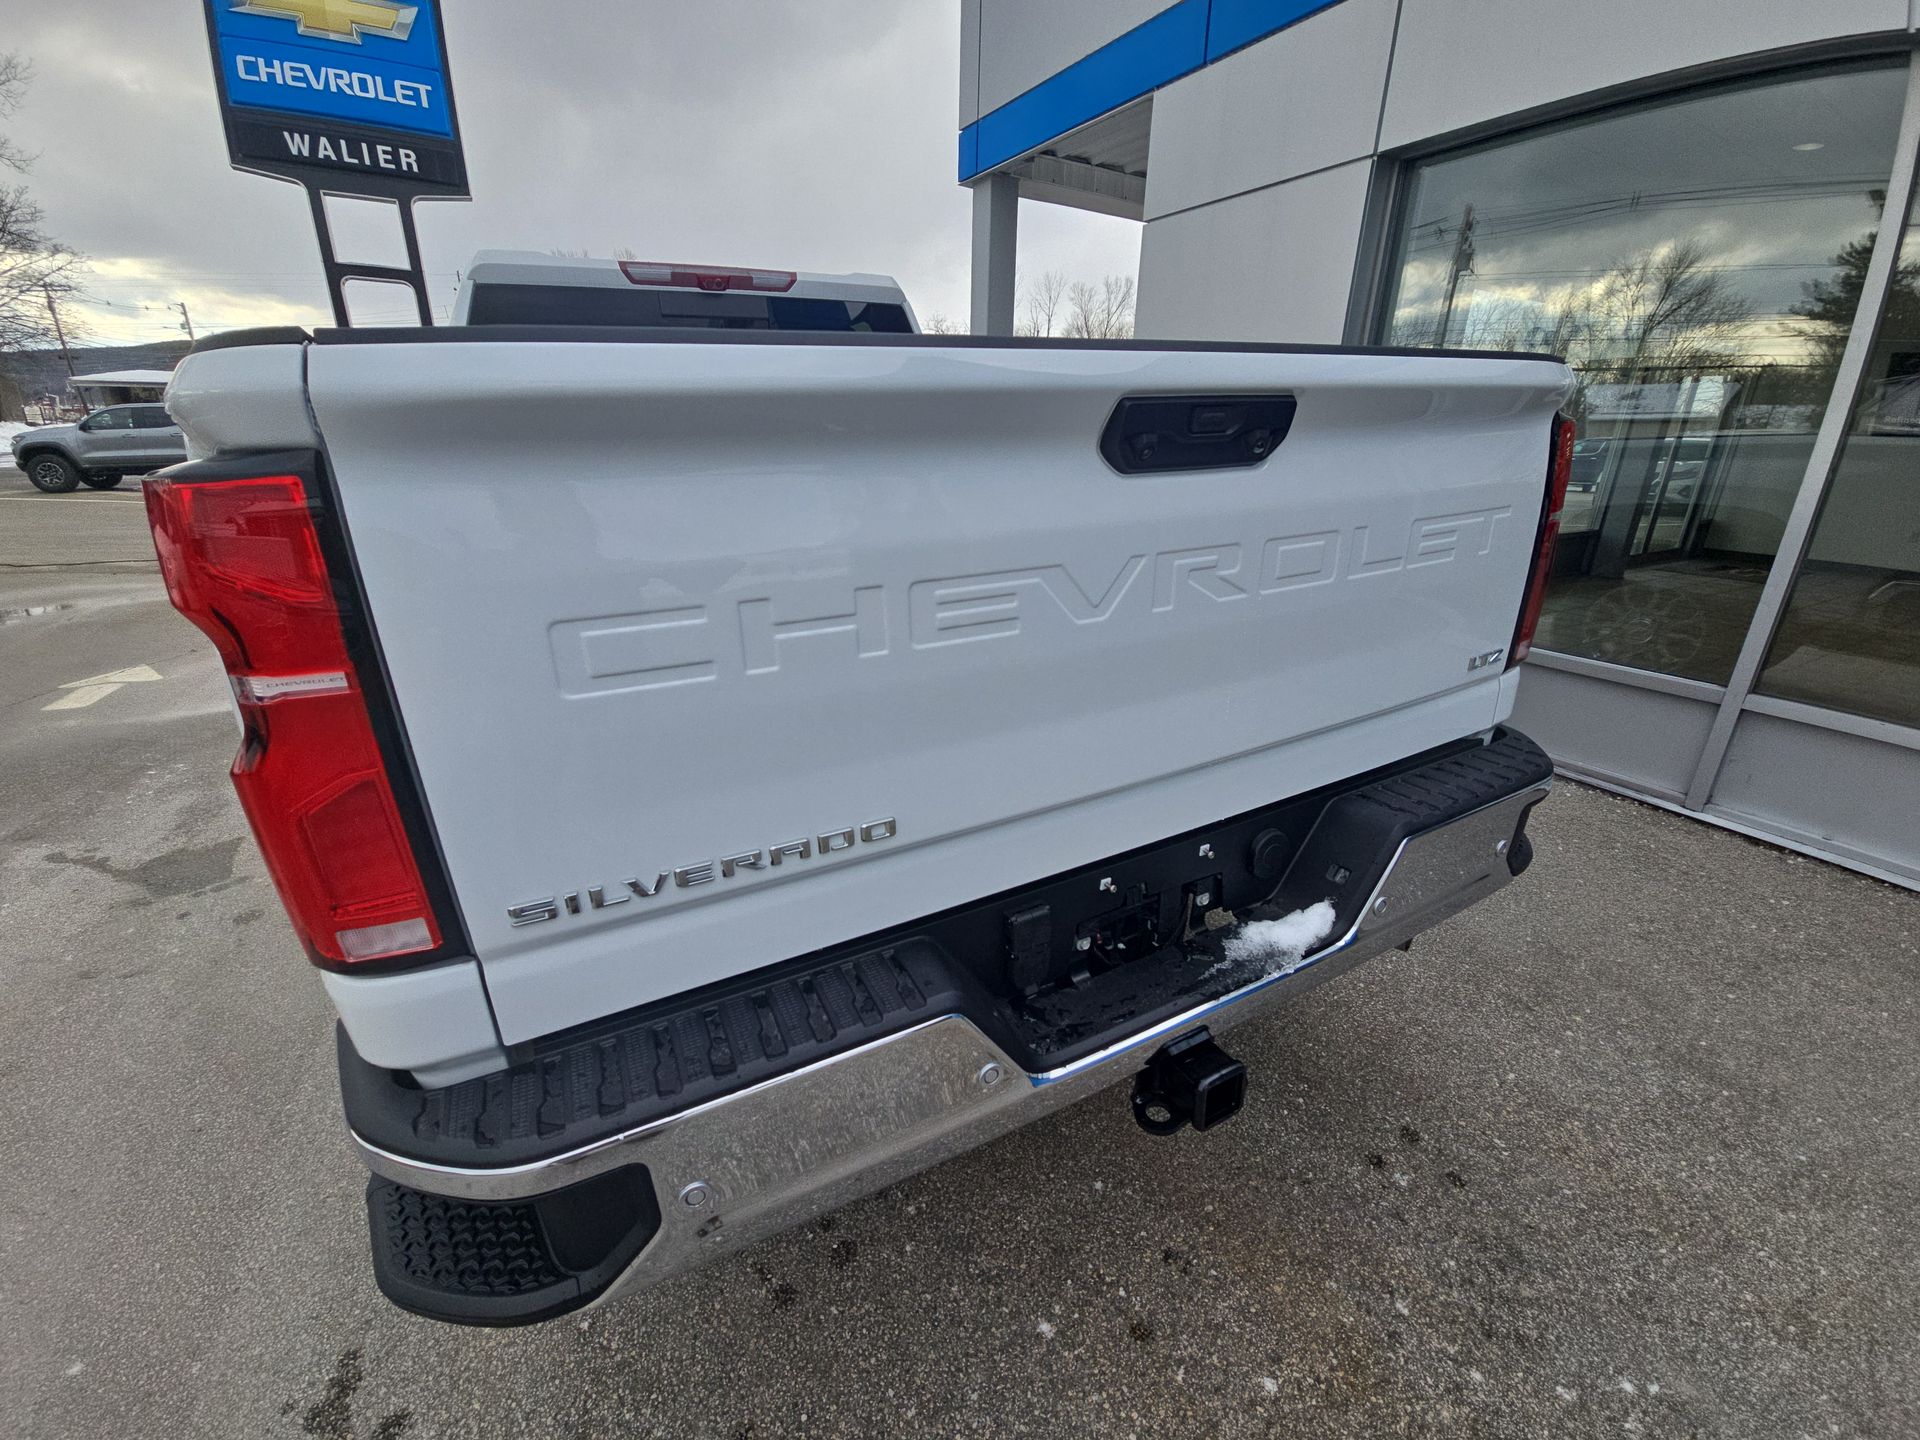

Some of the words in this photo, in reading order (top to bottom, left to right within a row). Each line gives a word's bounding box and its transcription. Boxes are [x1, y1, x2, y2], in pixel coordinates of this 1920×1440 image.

[236, 55, 432, 108] CHEVROLET
[283, 131, 420, 173] WALIER
[547, 505, 1512, 700] CHEVROLET
[1467, 648, 1504, 672] LTZ
[507, 816, 897, 927] SILVERADO
